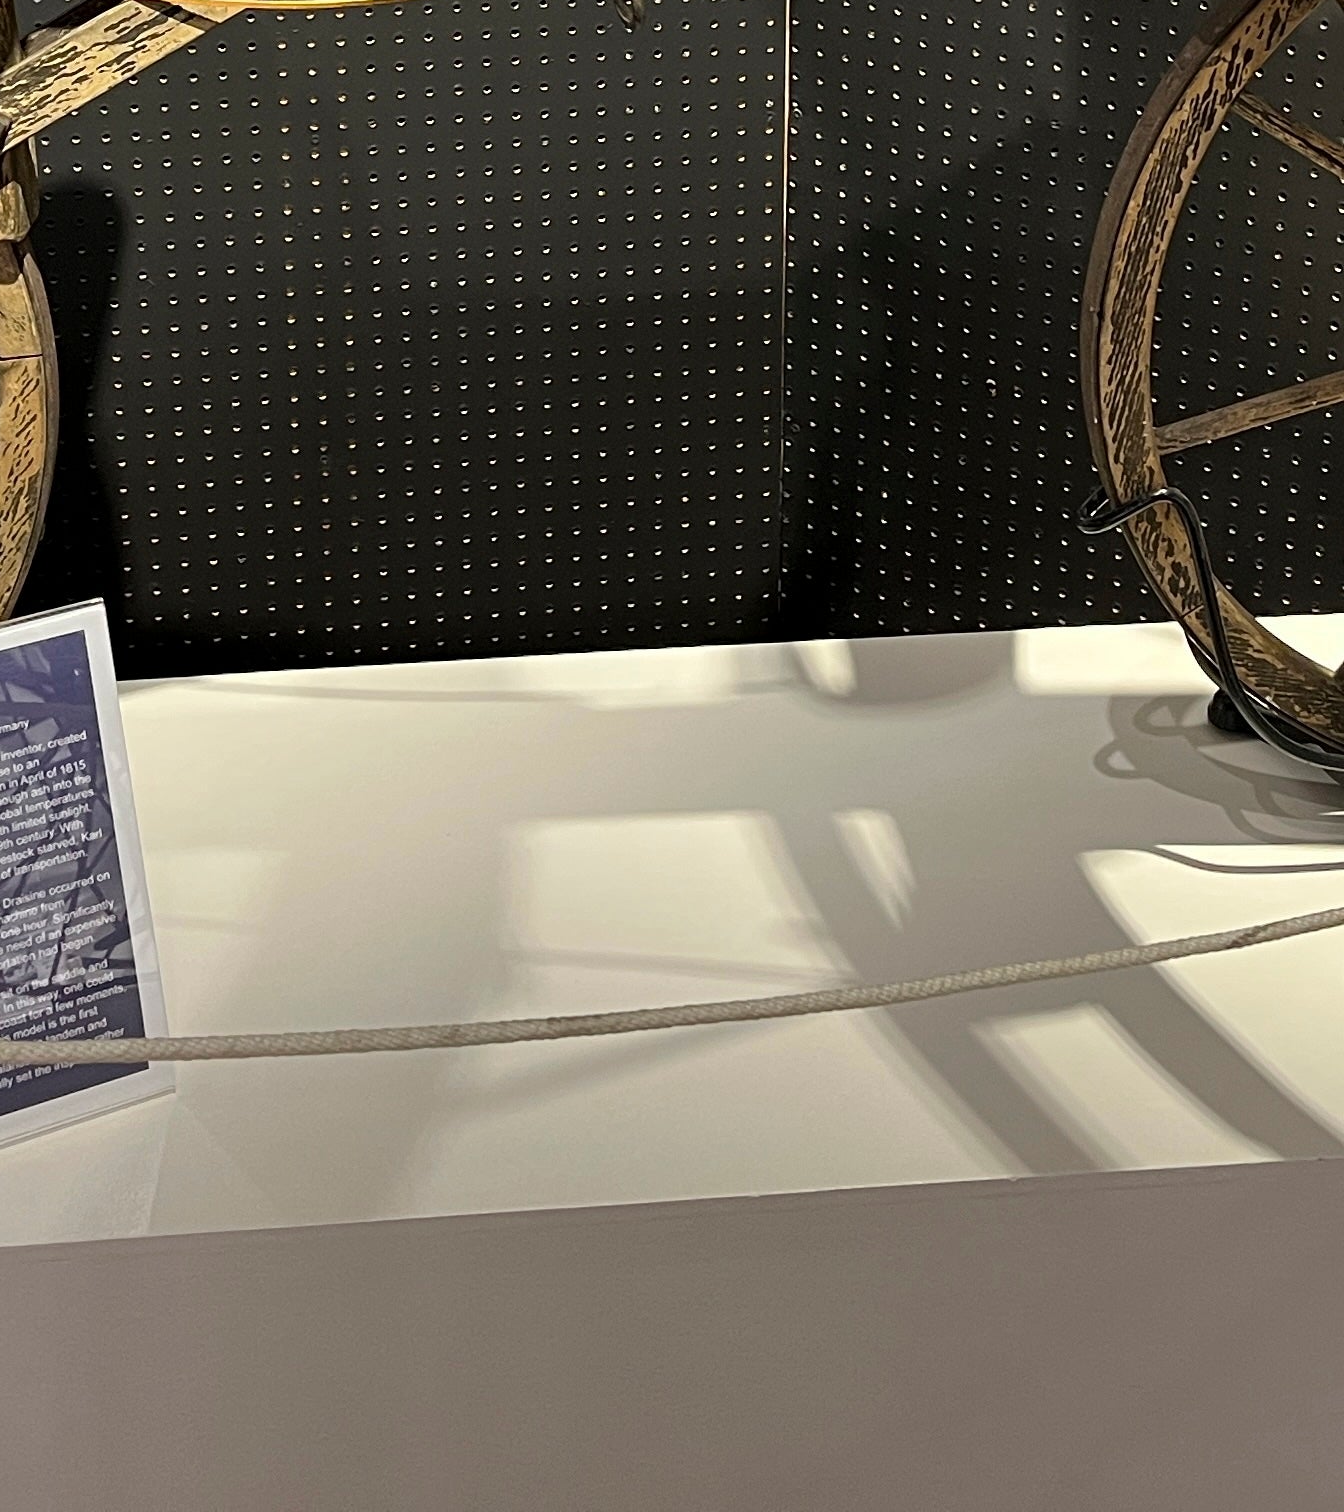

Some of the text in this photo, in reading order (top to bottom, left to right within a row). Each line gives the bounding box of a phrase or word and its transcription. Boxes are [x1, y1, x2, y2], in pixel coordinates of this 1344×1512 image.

[48, 731, 86, 748] created
[13, 764, 23, 772] to
[26, 760, 39, 769] an
[9, 780, 18, 788] in
[21, 771, 44, 785] April
[47, 768, 57, 778] of
[60, 760, 85, 774] 1815
[31, 784, 50, 797] ash
[53, 780, 71, 791] into
[75, 775, 91, 785] the
[60, 819, 83, 833] With
[81, 829, 102, 841] Karl
[0, 869, 10, 879] of
[3, 890, 46, 908] Draisine
[49, 875, 94, 895] occurred
[97, 872, 109, 881] on
[41, 900, 64, 912] from
[1, 927, 20, 938] one
[6, 937, 32, 952] need
[35, 933, 45, 943] of
[13, 1006, 97, 1039] model is the first
